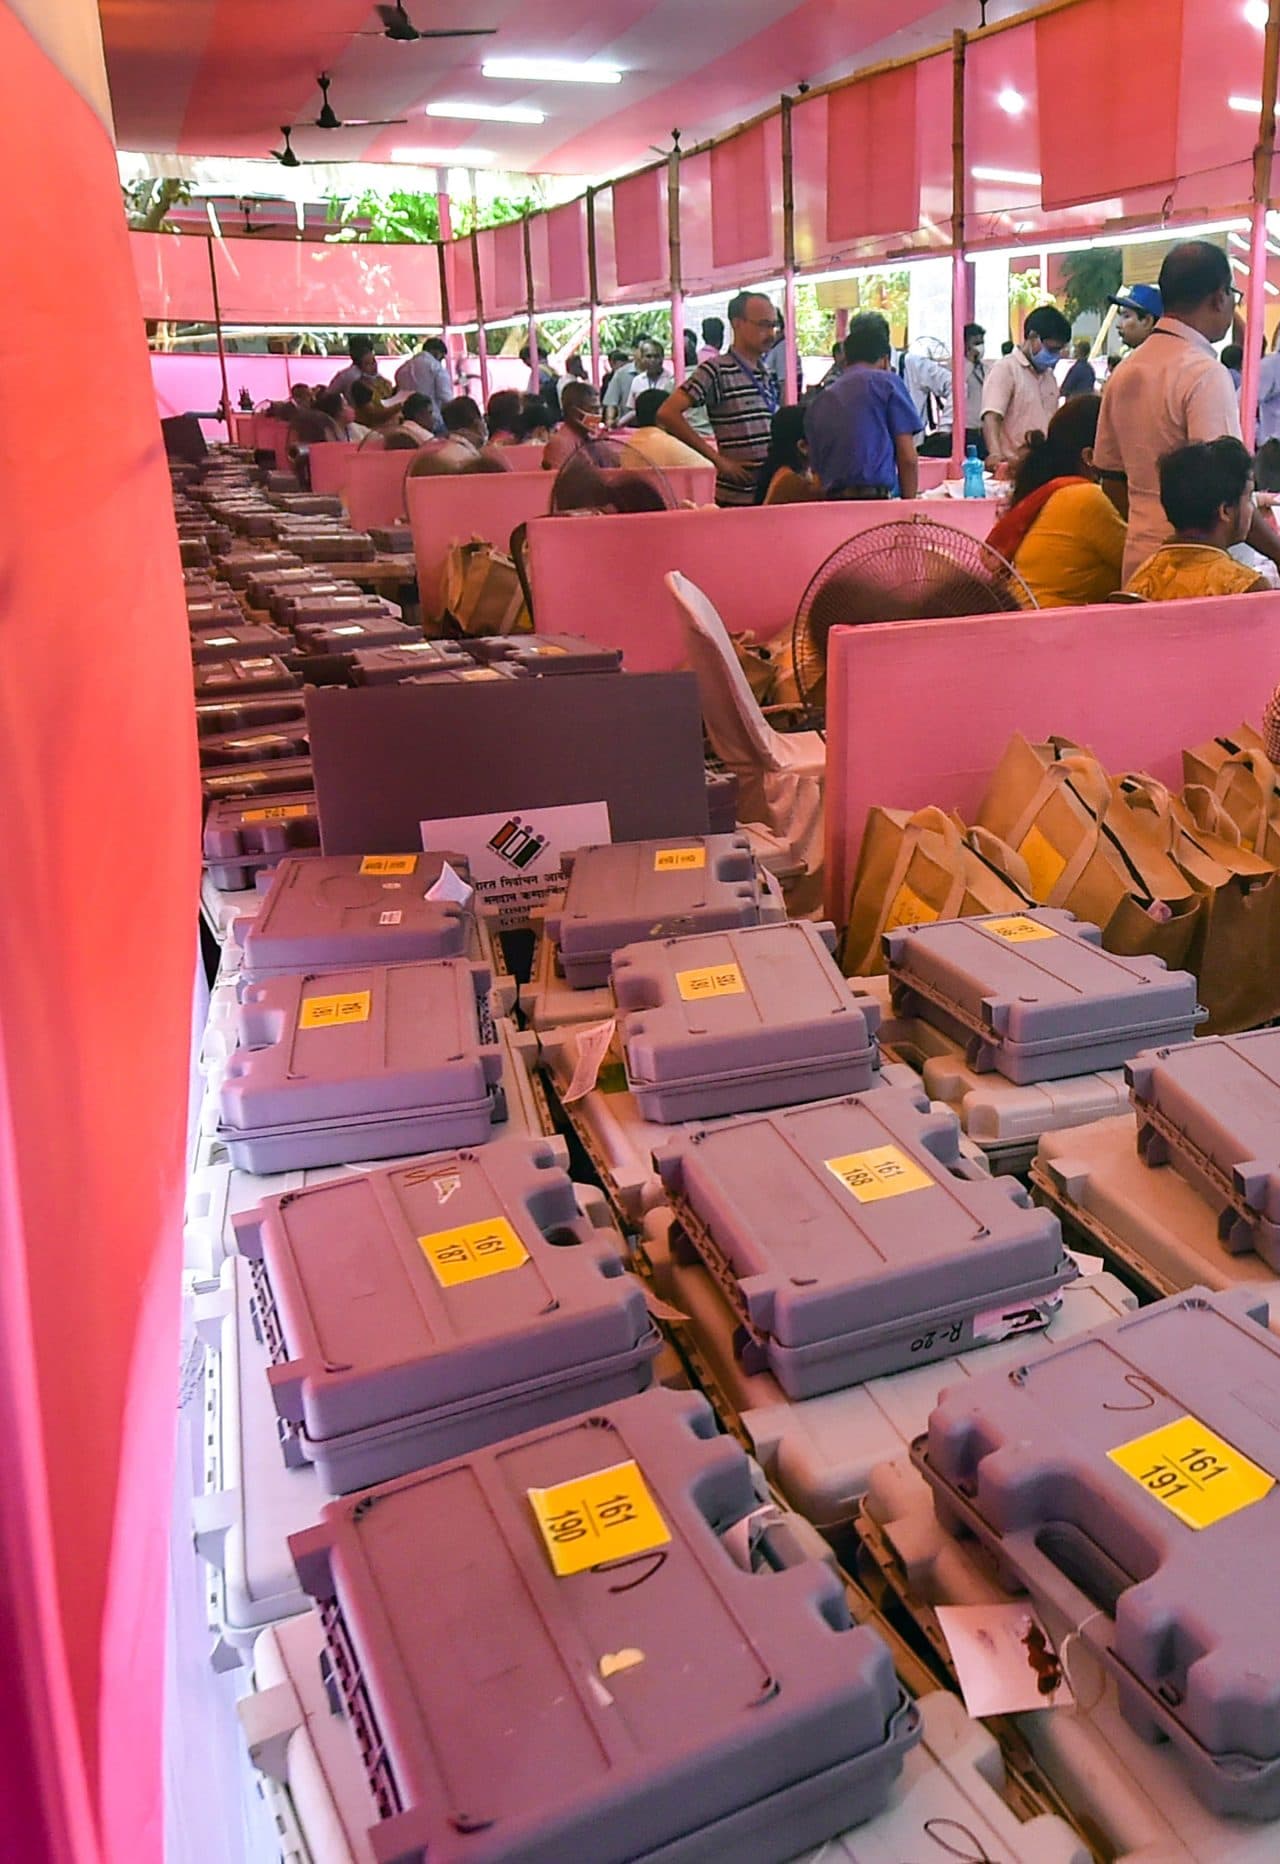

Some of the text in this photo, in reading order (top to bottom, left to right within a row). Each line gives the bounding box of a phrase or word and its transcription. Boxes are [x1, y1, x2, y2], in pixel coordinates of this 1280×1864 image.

[842, 1167, 874, 1187] 188
[872, 1160, 905, 1179] 161
[434, 1244, 468, 1264] 187
[473, 1235, 506, 1256] 161
[1179, 1447, 1230, 1482] 161
[1139, 1464, 1191, 1499] 191
[596, 1493, 639, 1528] 161
[545, 1509, 588, 1544] 190
